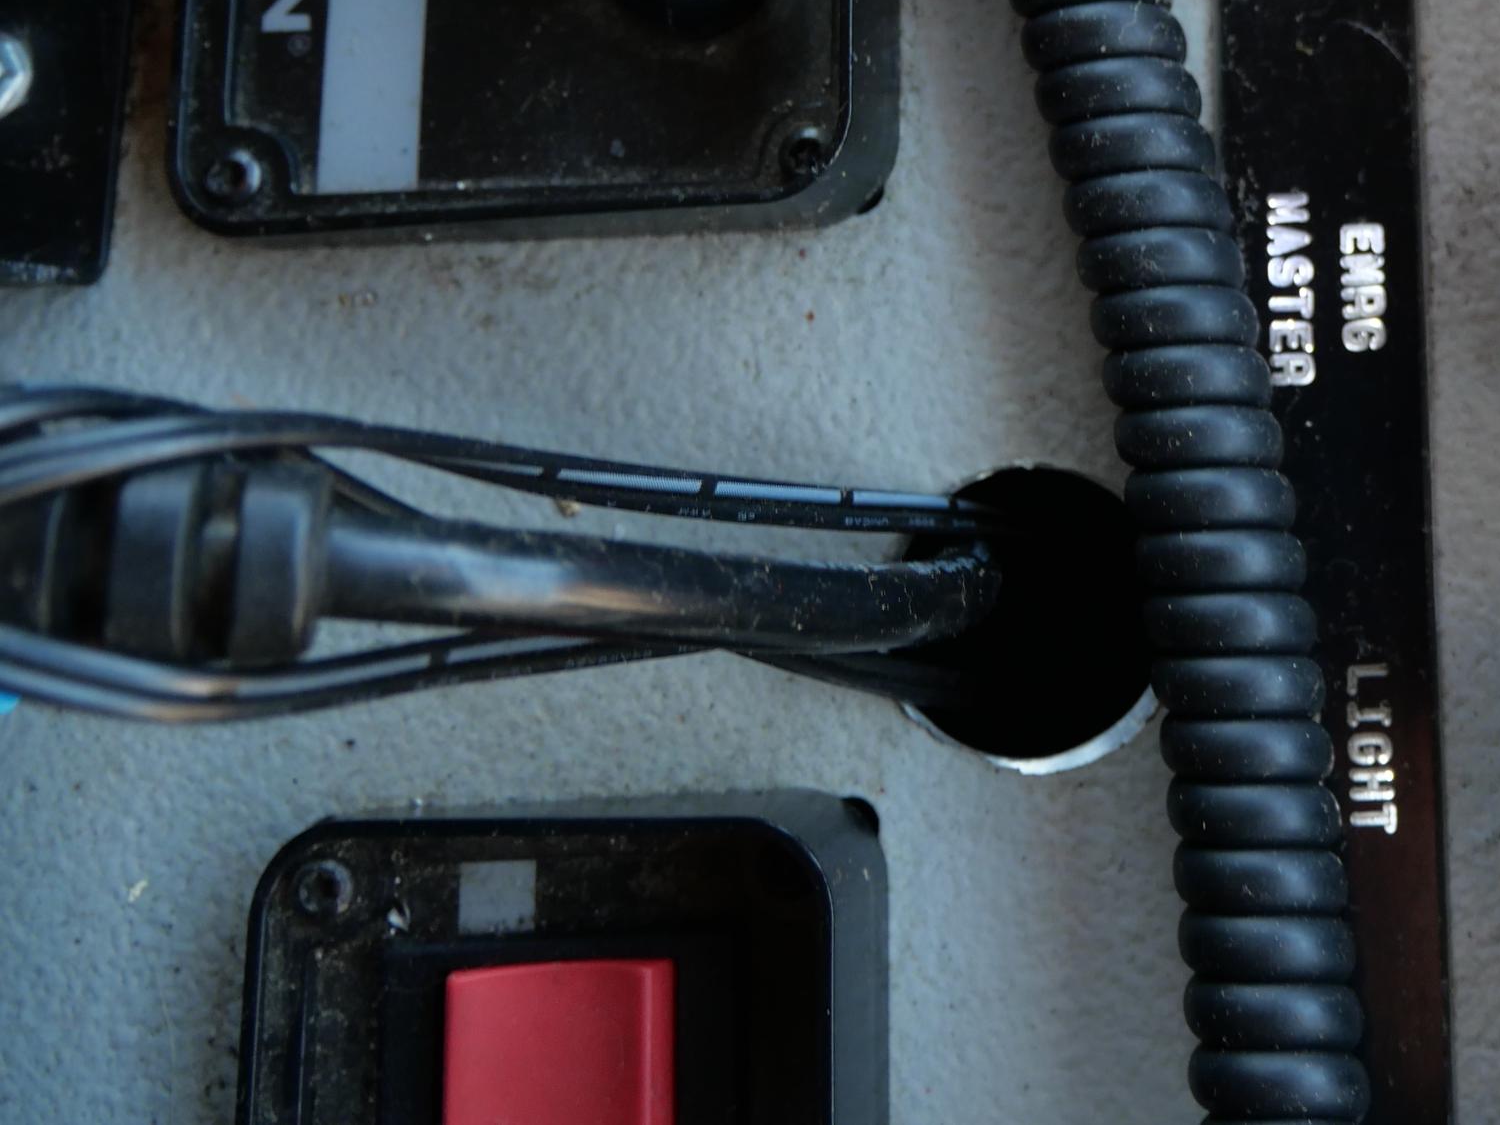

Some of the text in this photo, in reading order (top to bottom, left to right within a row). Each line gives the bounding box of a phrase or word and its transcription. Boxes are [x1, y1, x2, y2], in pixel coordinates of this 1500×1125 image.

[1266, 191, 1316, 387] MASTER
[1339, 221, 1387, 353] EMRG
[1346, 662, 1398, 835] LIGHT
